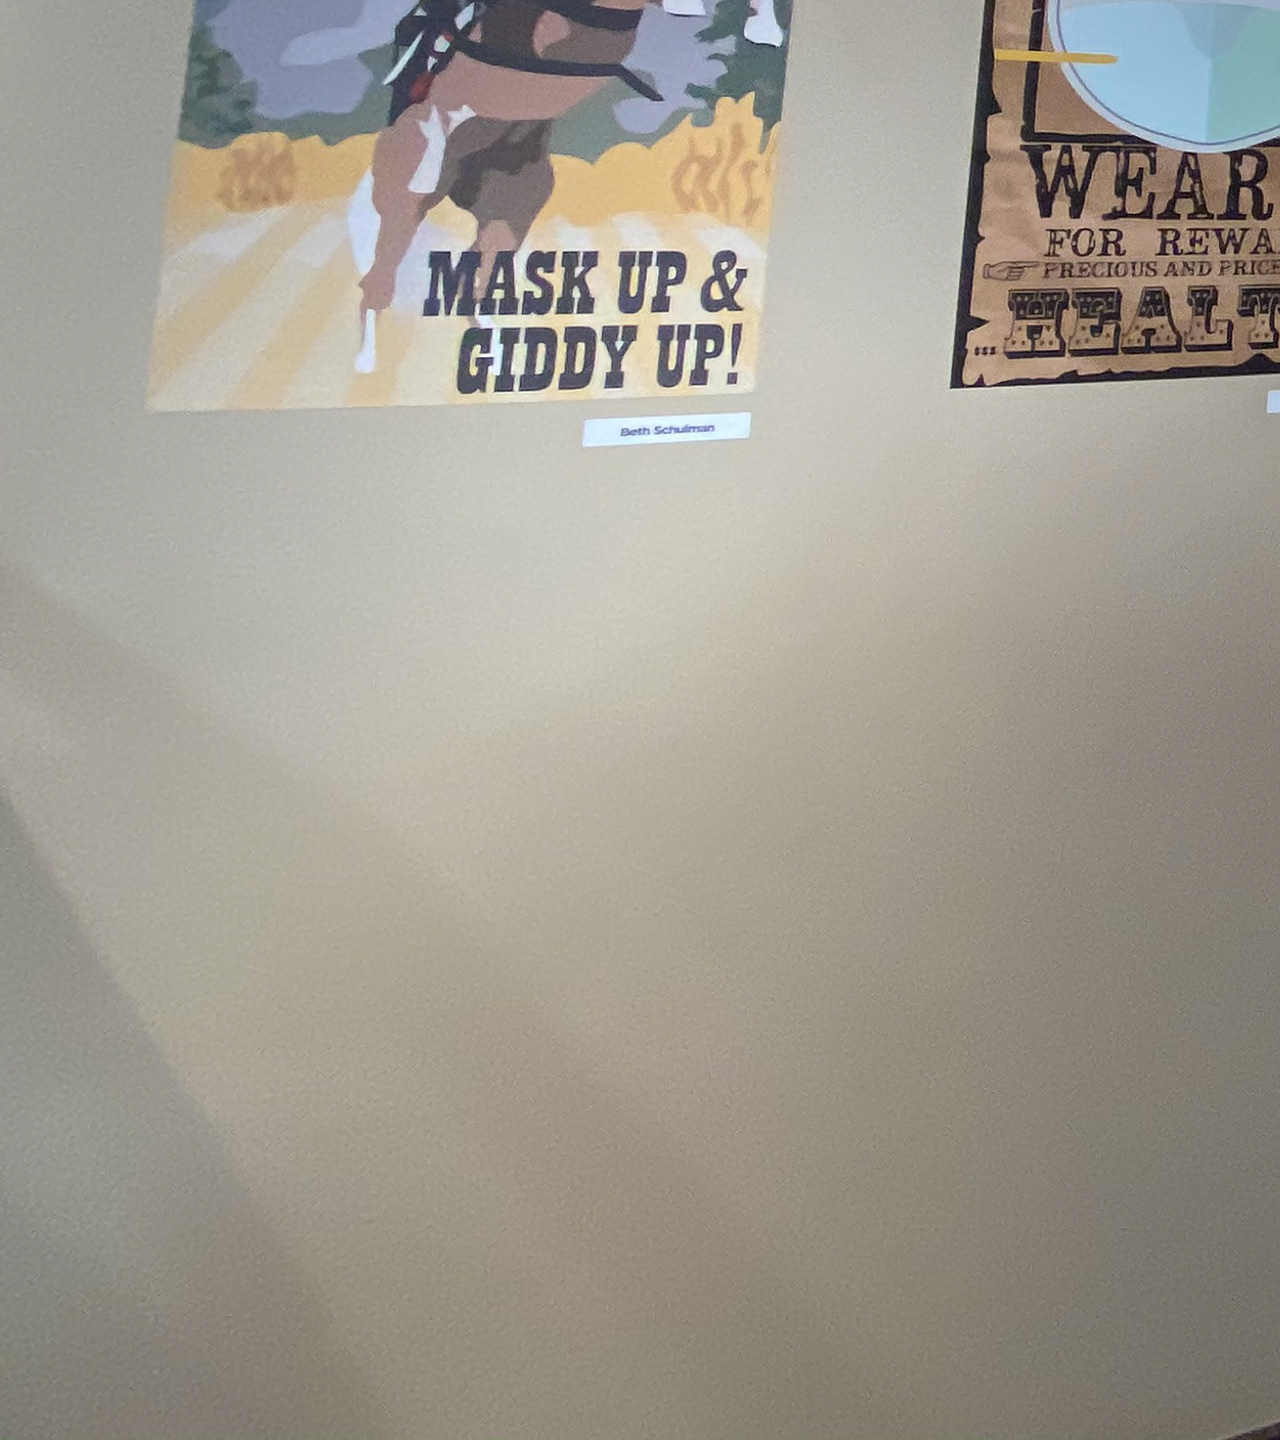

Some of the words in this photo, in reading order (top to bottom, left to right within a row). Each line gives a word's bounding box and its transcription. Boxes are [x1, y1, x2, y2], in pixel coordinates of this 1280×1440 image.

[1019, 144, 1274, 220] WEAR
[1044, 228, 1126, 258] FOR
[422, 250, 598, 316] MASK
[617, 250, 688, 314] UP
[700, 250, 748, 312] &
[1042, 261, 1158, 280] PRECIOUS
[1164, 260, 1213, 278] AND
[456, 324, 639, 394] GIDDY
[656, 322, 744, 387] UP!
[620, 427, 650, 437] Beth
[654, 424, 715, 435] Schulman
